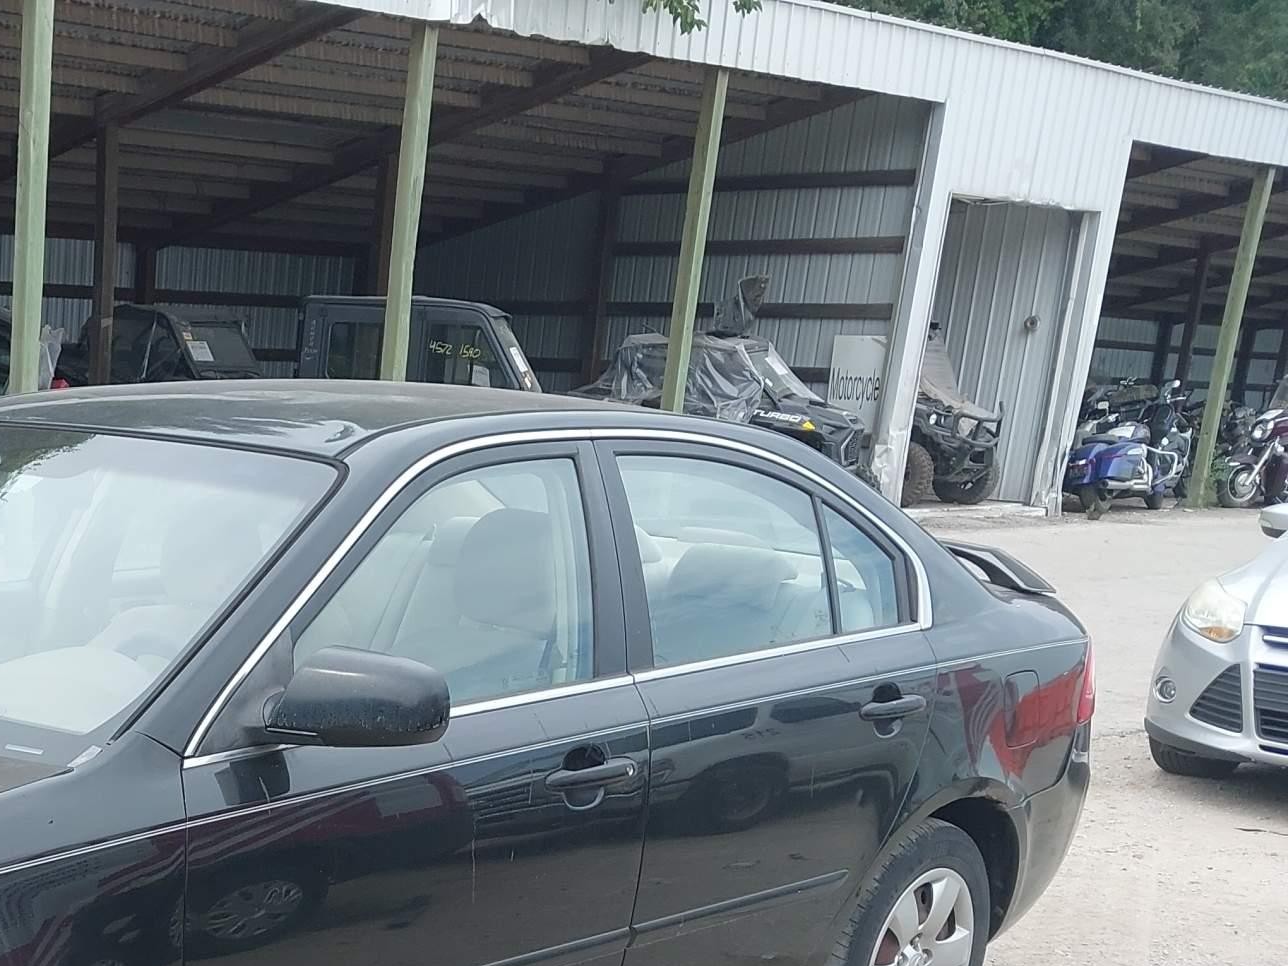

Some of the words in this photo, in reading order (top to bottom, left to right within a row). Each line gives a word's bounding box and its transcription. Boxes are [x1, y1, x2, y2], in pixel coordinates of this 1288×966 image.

[429, 339, 453, 355] 4572
[830, 367, 881, 410] Motorcycle
[753, 409, 802, 423] TURBO
